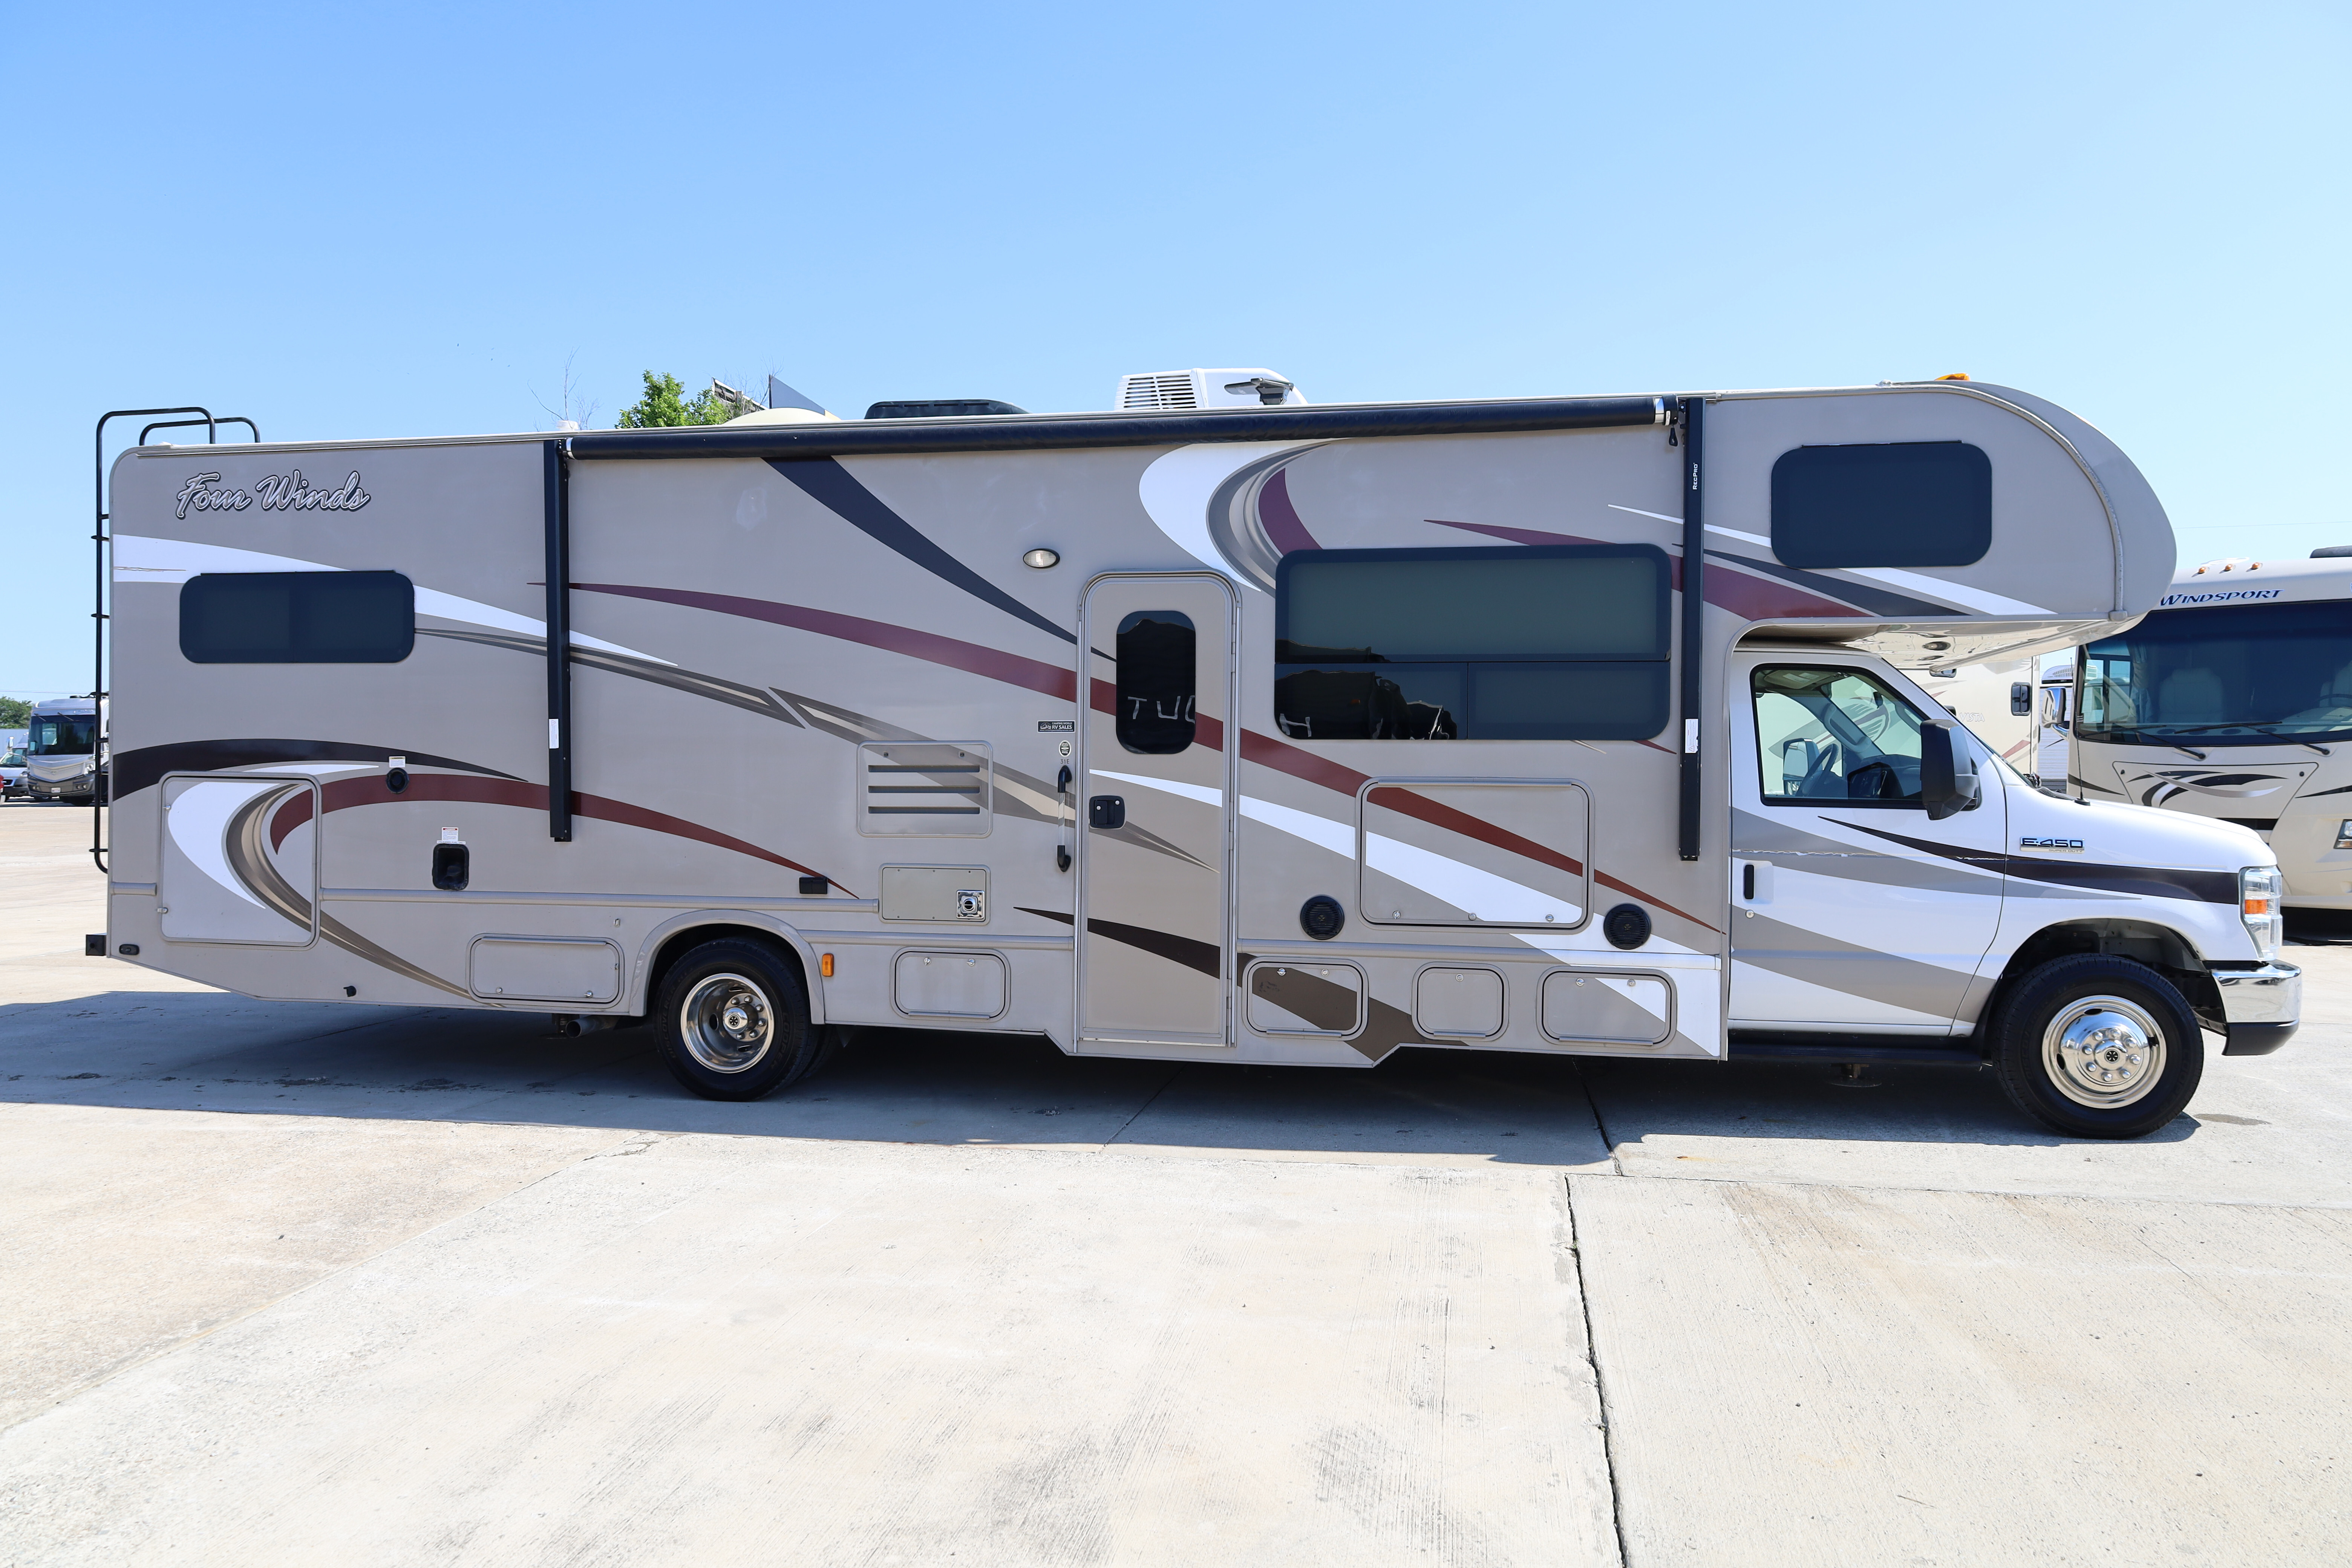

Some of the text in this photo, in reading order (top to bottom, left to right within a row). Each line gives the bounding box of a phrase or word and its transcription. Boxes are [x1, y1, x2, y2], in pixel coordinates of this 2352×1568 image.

[175, 469, 372, 520] Four Winds
[2160, 589, 2284, 606] WINDSPORT
[1960, 712, 1985, 722] VISTA
[770, 1012, 790, 1069] COOPER
